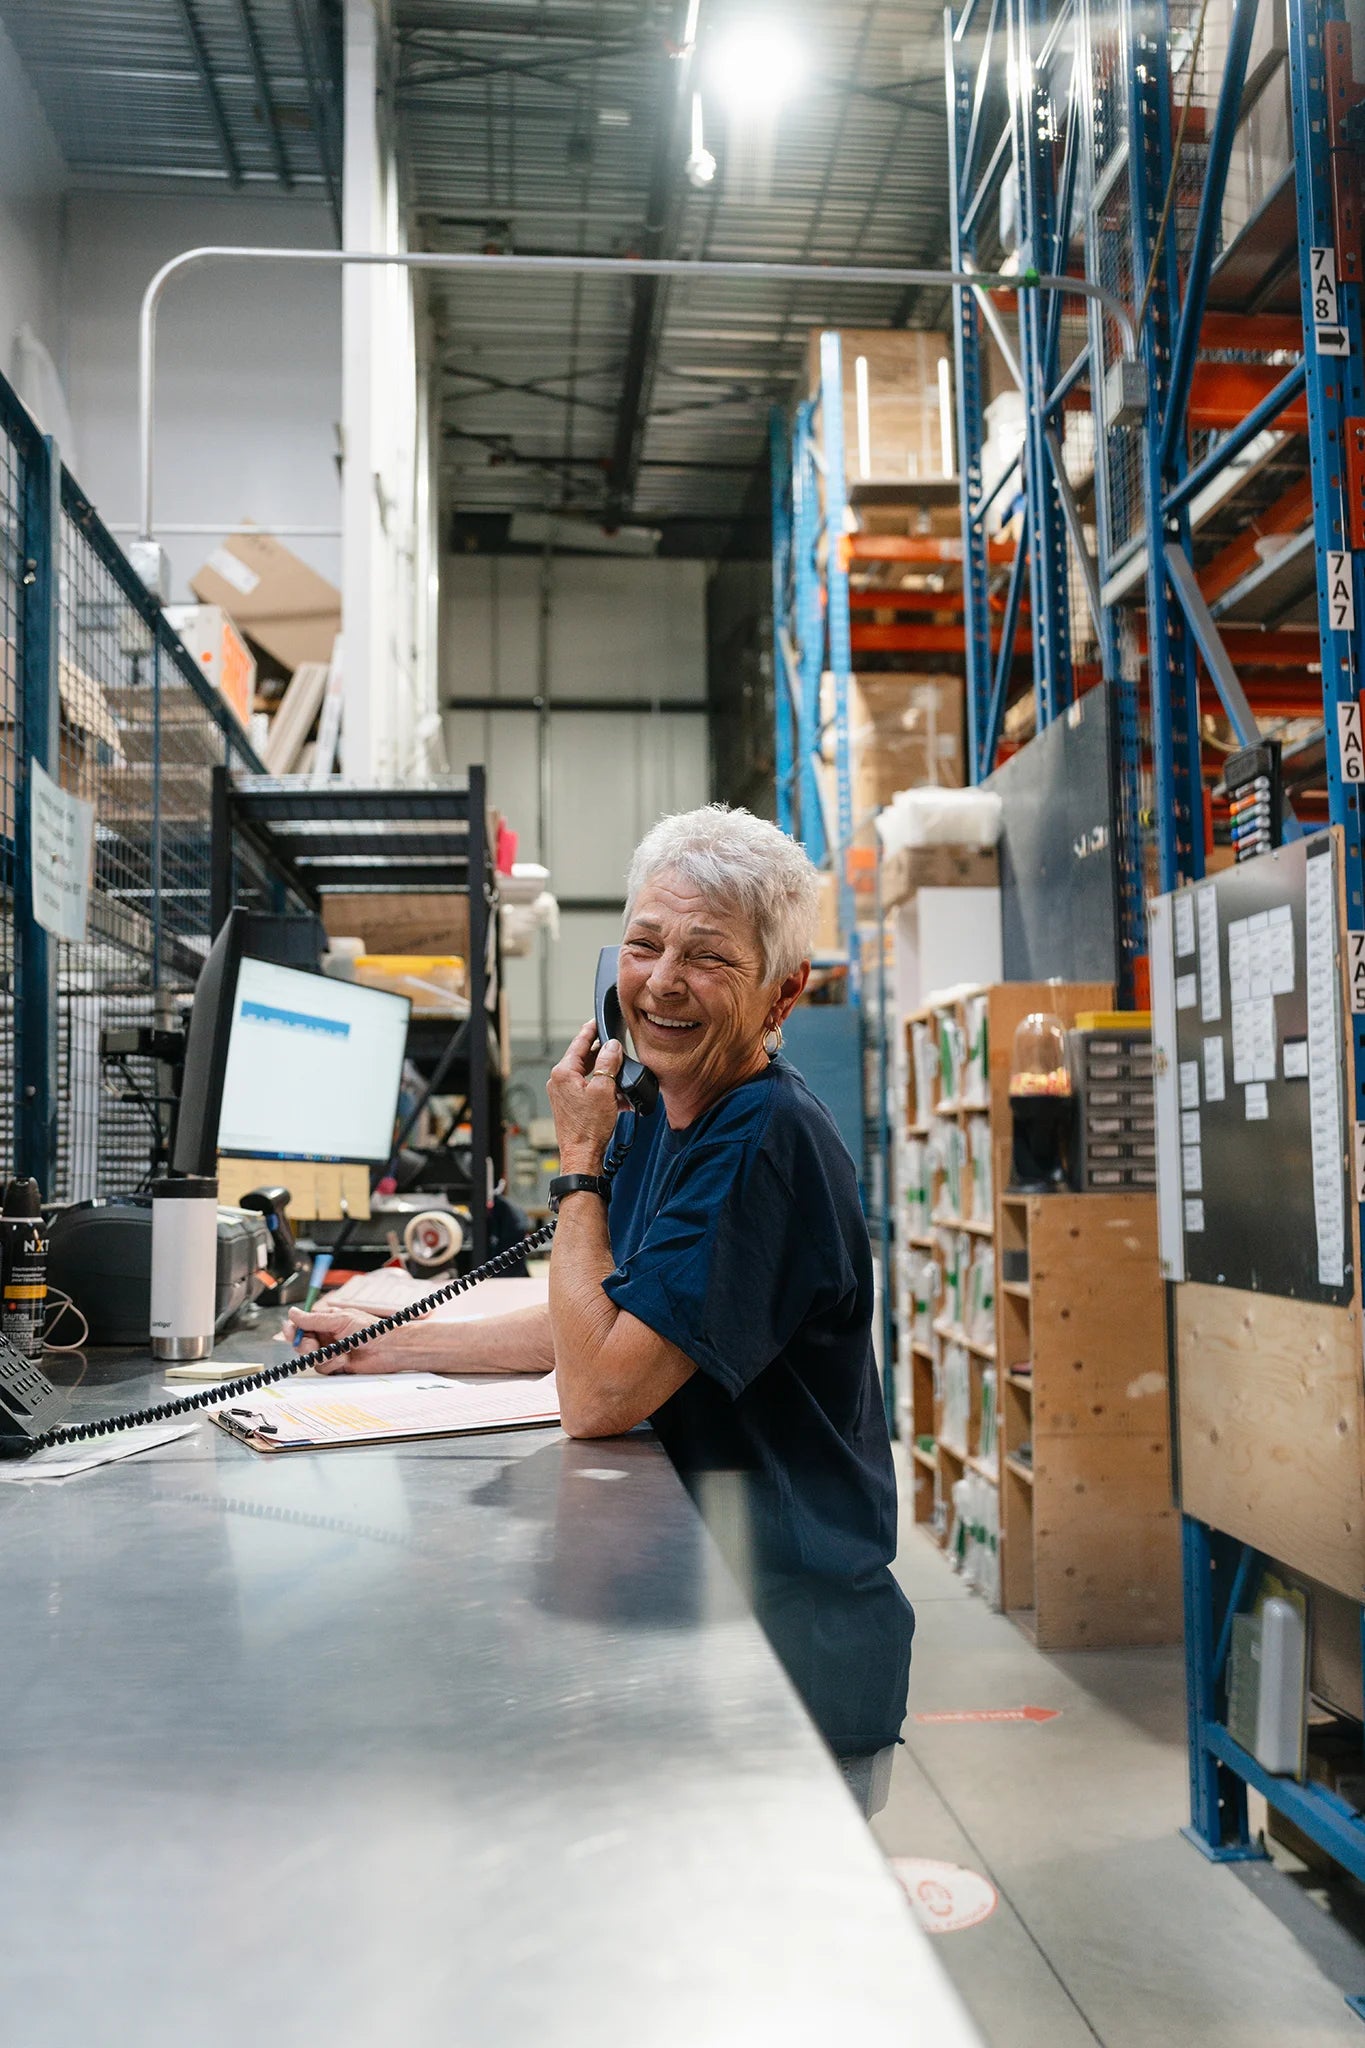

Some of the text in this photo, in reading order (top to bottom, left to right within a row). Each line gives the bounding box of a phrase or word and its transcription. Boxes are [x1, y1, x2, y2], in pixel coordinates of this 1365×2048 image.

[1312, 249, 1334, 319] 7A8
[1331, 554, 1350, 626] 7A7
[1341, 705, 1362, 778] 7A6
[23, 1239, 50, 1252] NXT
